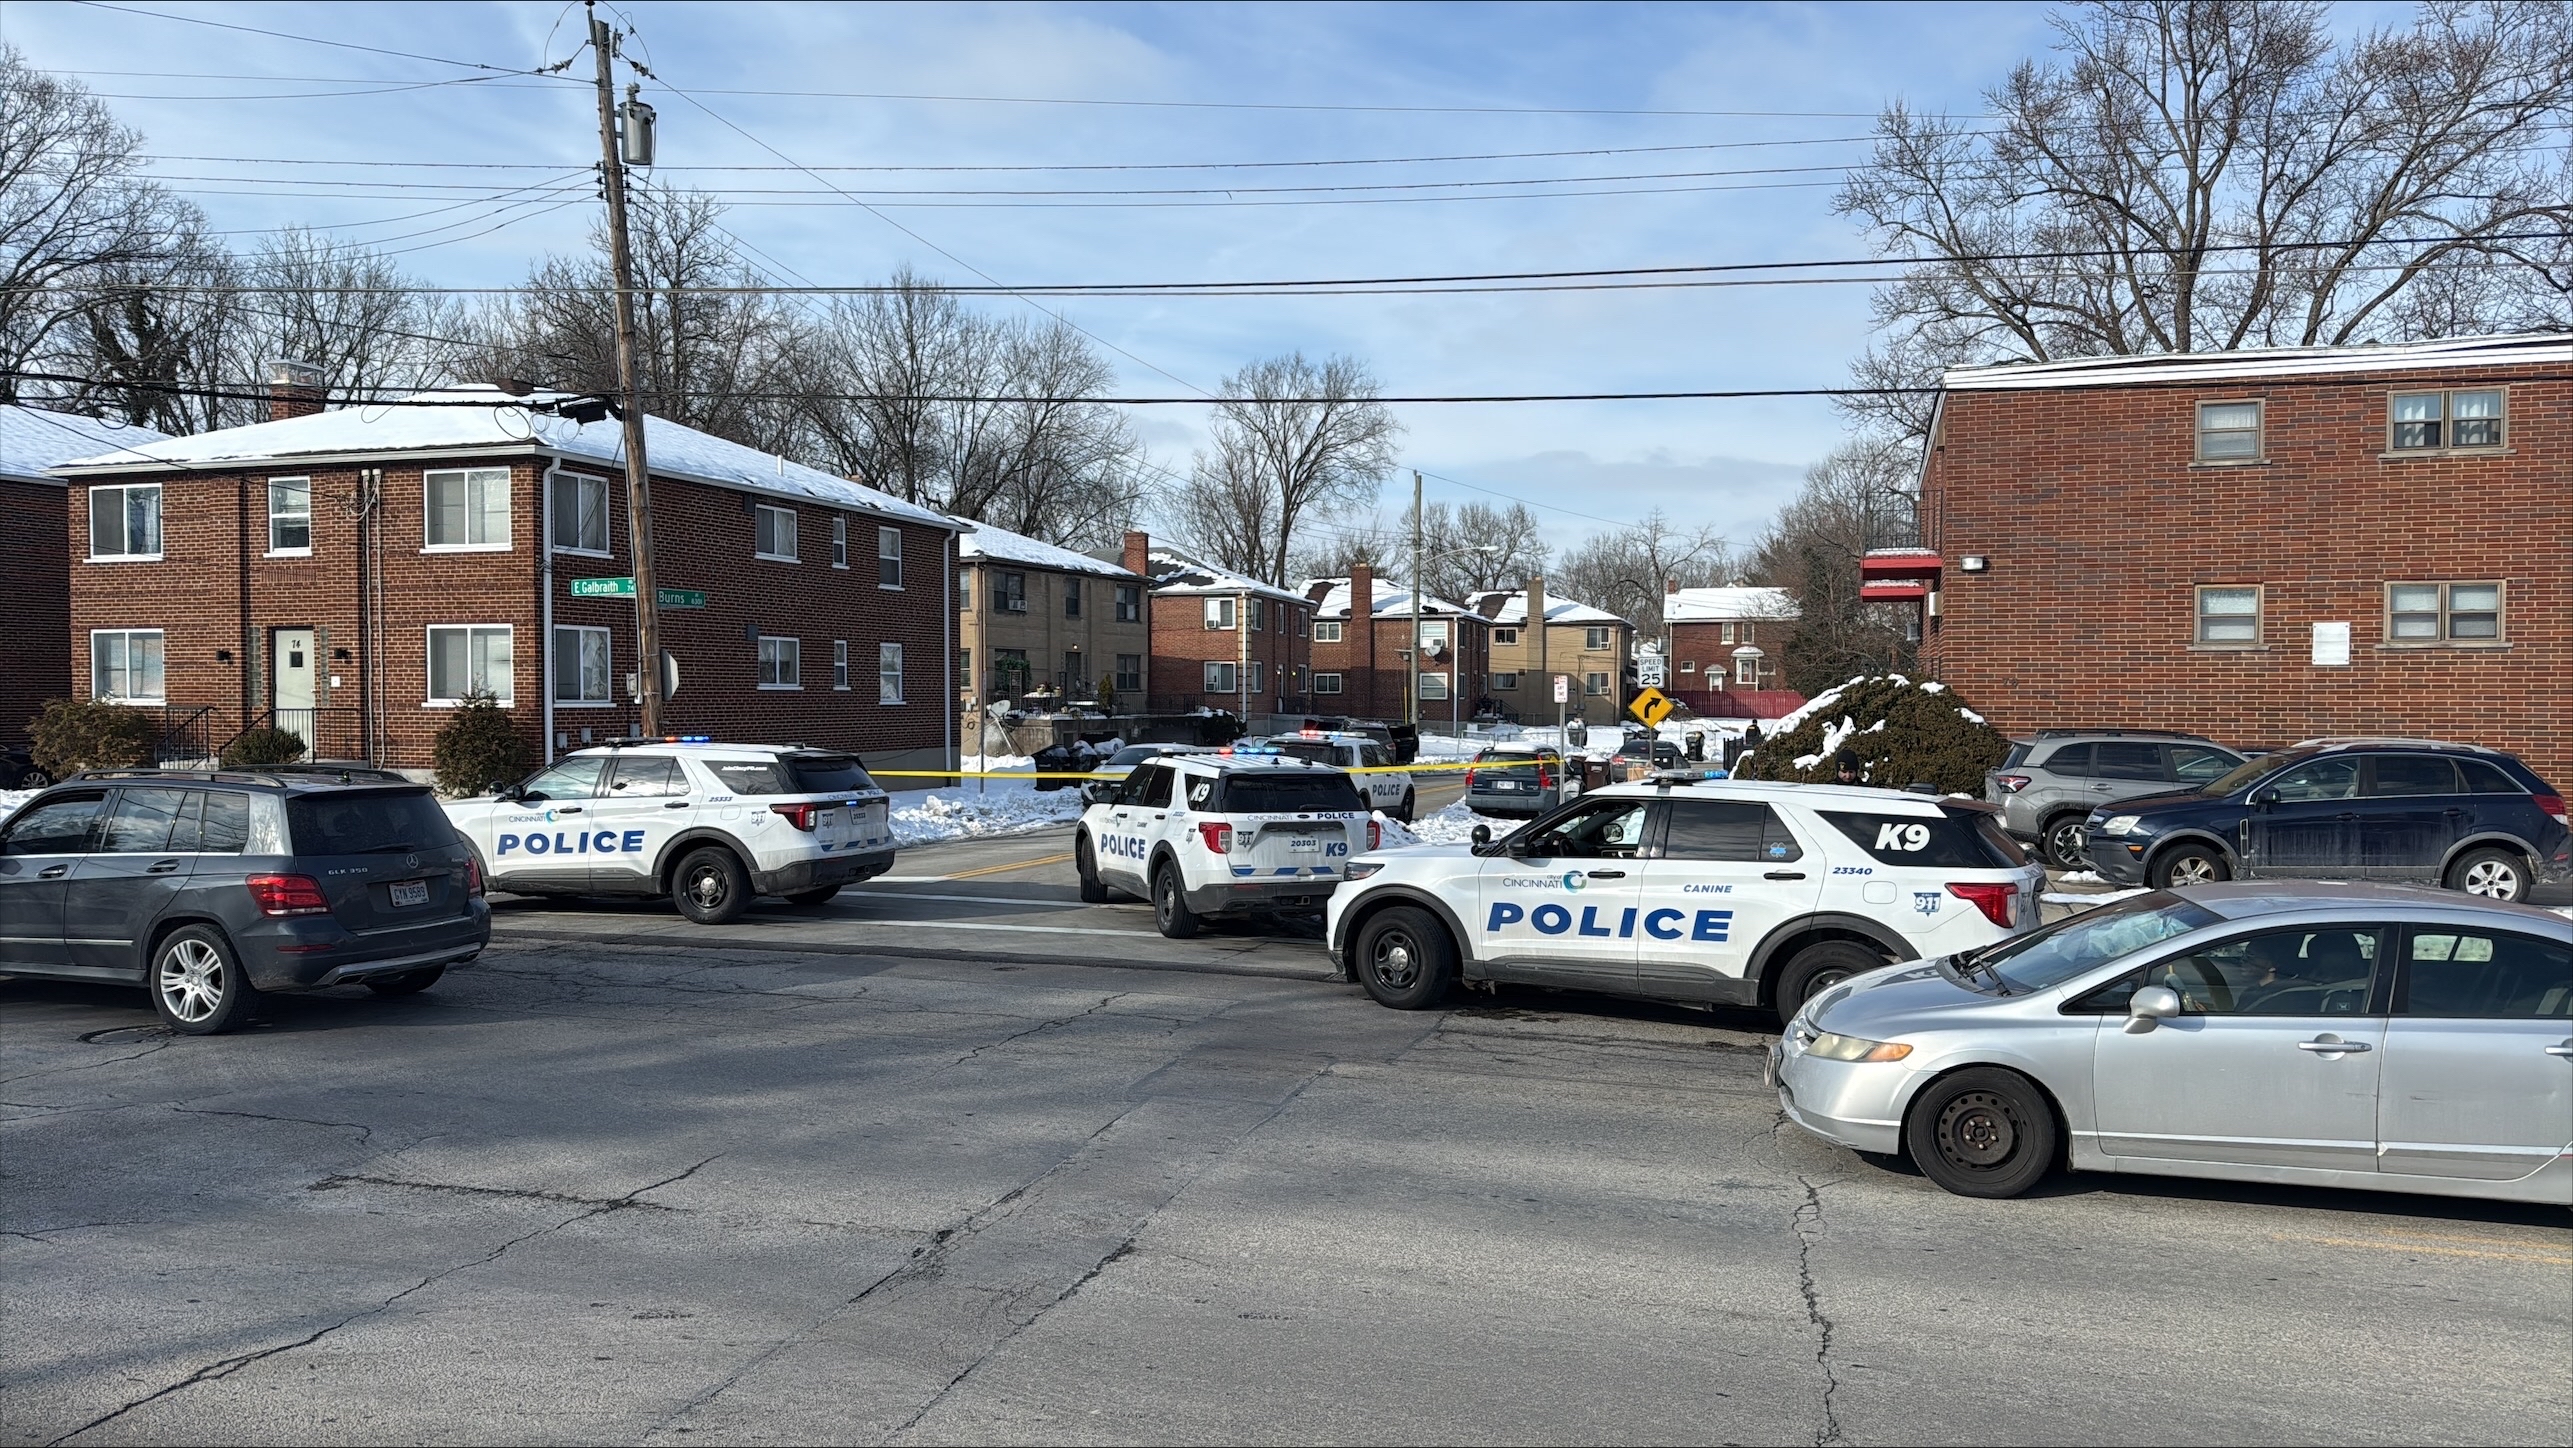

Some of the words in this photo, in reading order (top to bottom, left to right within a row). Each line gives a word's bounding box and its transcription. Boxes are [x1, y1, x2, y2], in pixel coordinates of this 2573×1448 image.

[574, 581, 580, 594] E
[581, 580, 619, 593] Galbraith
[658, 590, 685, 604] Burns
[291, 639, 301, 649] 74
[1641, 673, 1661, 685] 25
[1190, 783, 1210, 803] K9
[1372, 784, 1400, 797] POLICE
[508, 815, 546, 823] CINCINNATI
[751, 813, 765, 824] 911
[1317, 812, 1355, 820] POLICE
[497, 830, 645, 856] POLICE
[1238, 834, 1253, 843] 911
[1874, 823, 1931, 851] K9
[1100, 833, 1146, 860] POLICE
[1325, 842, 1348, 857] K9
[1832, 866, 1873, 876] 23340
[1502, 877, 1563, 889] CINCINNATI
[1683, 884, 1733, 894] CANINE
[1914, 896, 1941, 910] 911
[1486, 901, 1734, 942] POLICE
